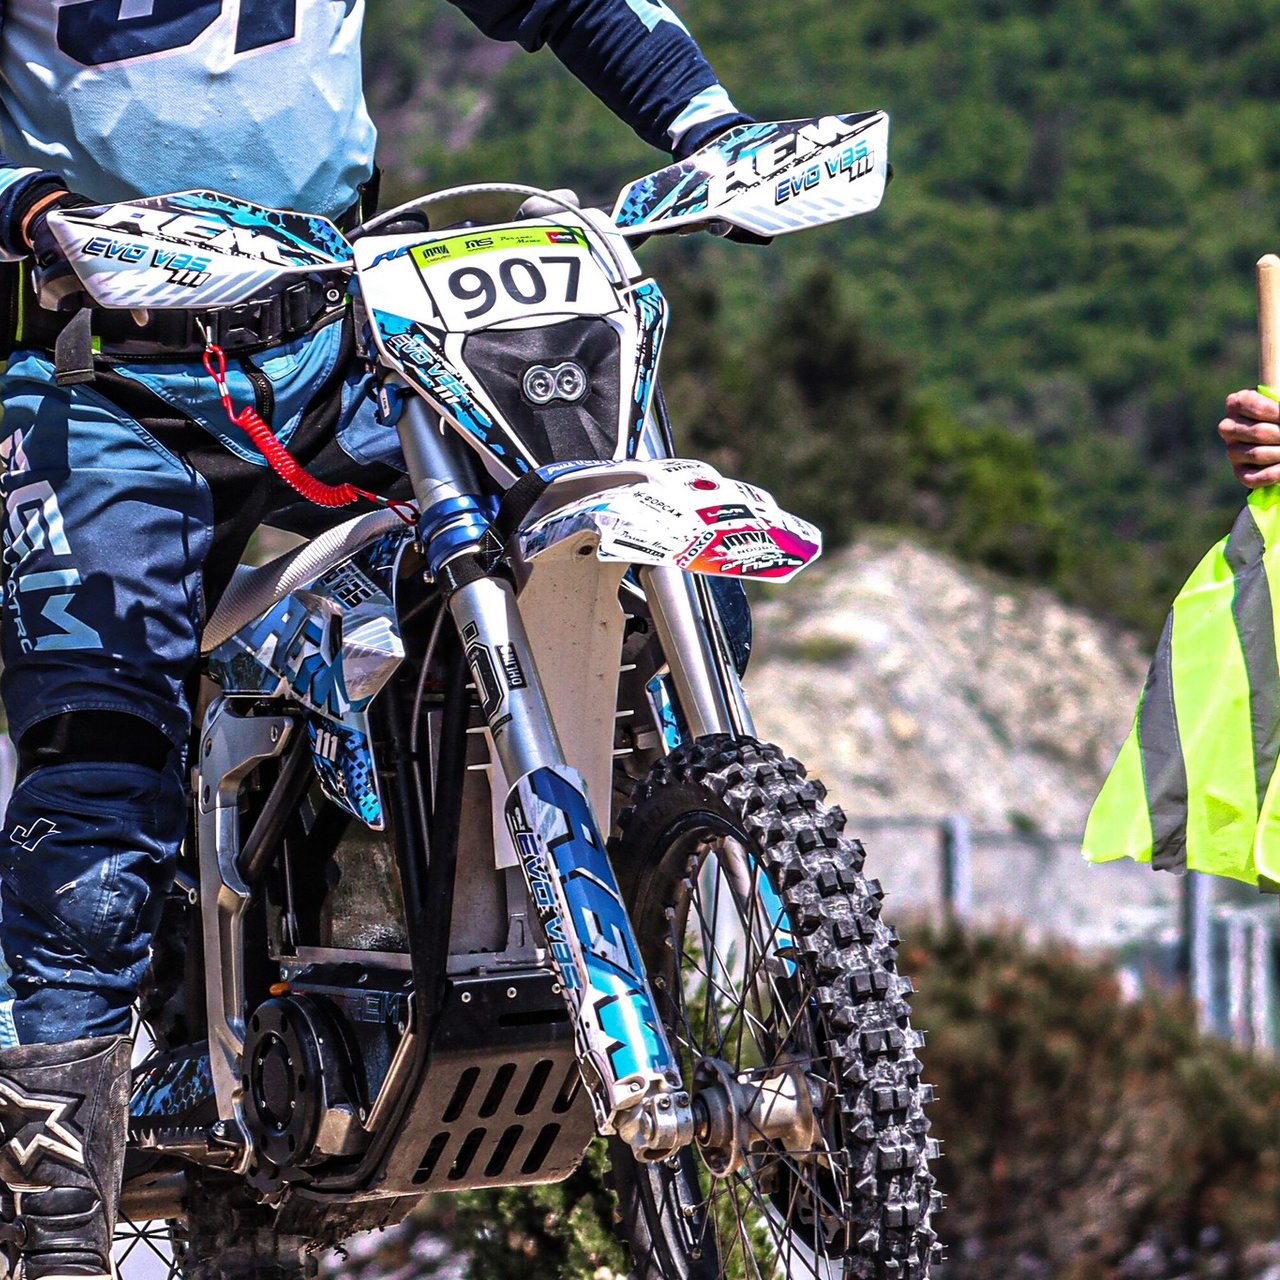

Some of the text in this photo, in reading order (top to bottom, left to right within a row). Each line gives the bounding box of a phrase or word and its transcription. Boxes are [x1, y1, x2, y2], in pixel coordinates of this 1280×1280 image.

[775, 163, 820, 206] EVO
[81, 236, 150, 265] EVO
[447, 256, 582, 319] 907
[391, 333, 435, 365] EVO
[516, 831, 557, 907] EVO
